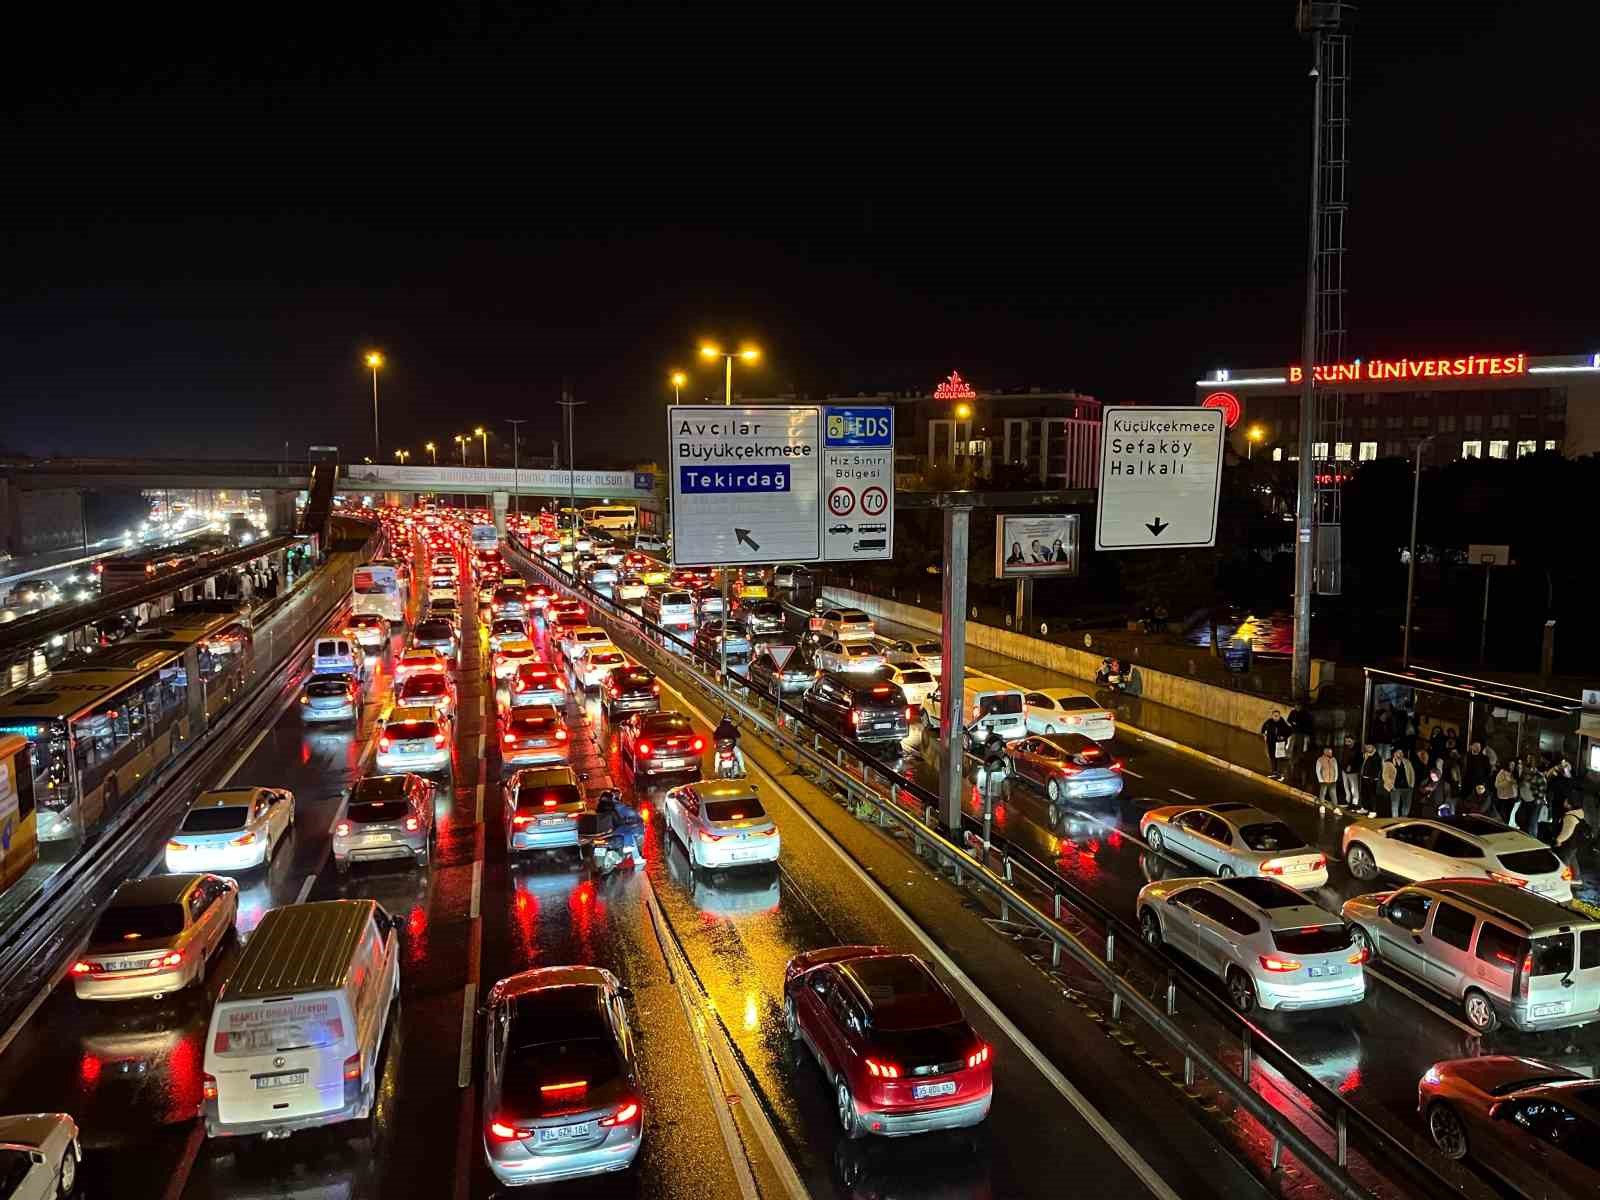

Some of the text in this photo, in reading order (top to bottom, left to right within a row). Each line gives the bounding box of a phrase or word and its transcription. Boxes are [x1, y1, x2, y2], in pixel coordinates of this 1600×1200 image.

[1289, 353, 1525, 381] BRUNİ ÜNİVERSİTESİ
[679, 420, 761, 436] Avcılar
[855, 416, 889, 437] EDS
[1113, 420, 1216, 434] Küçükçekmece
[679, 443, 812, 461] Büyükçekmece
[1112, 438, 1193, 457] Sefaköy
[830, 455, 849, 465] Hız
[1110, 460, 1184, 475] Halkalı
[686, 471, 786, 490] Tekirdağ
[833, 494, 850, 509] 80
[866, 494, 882, 508] 70
